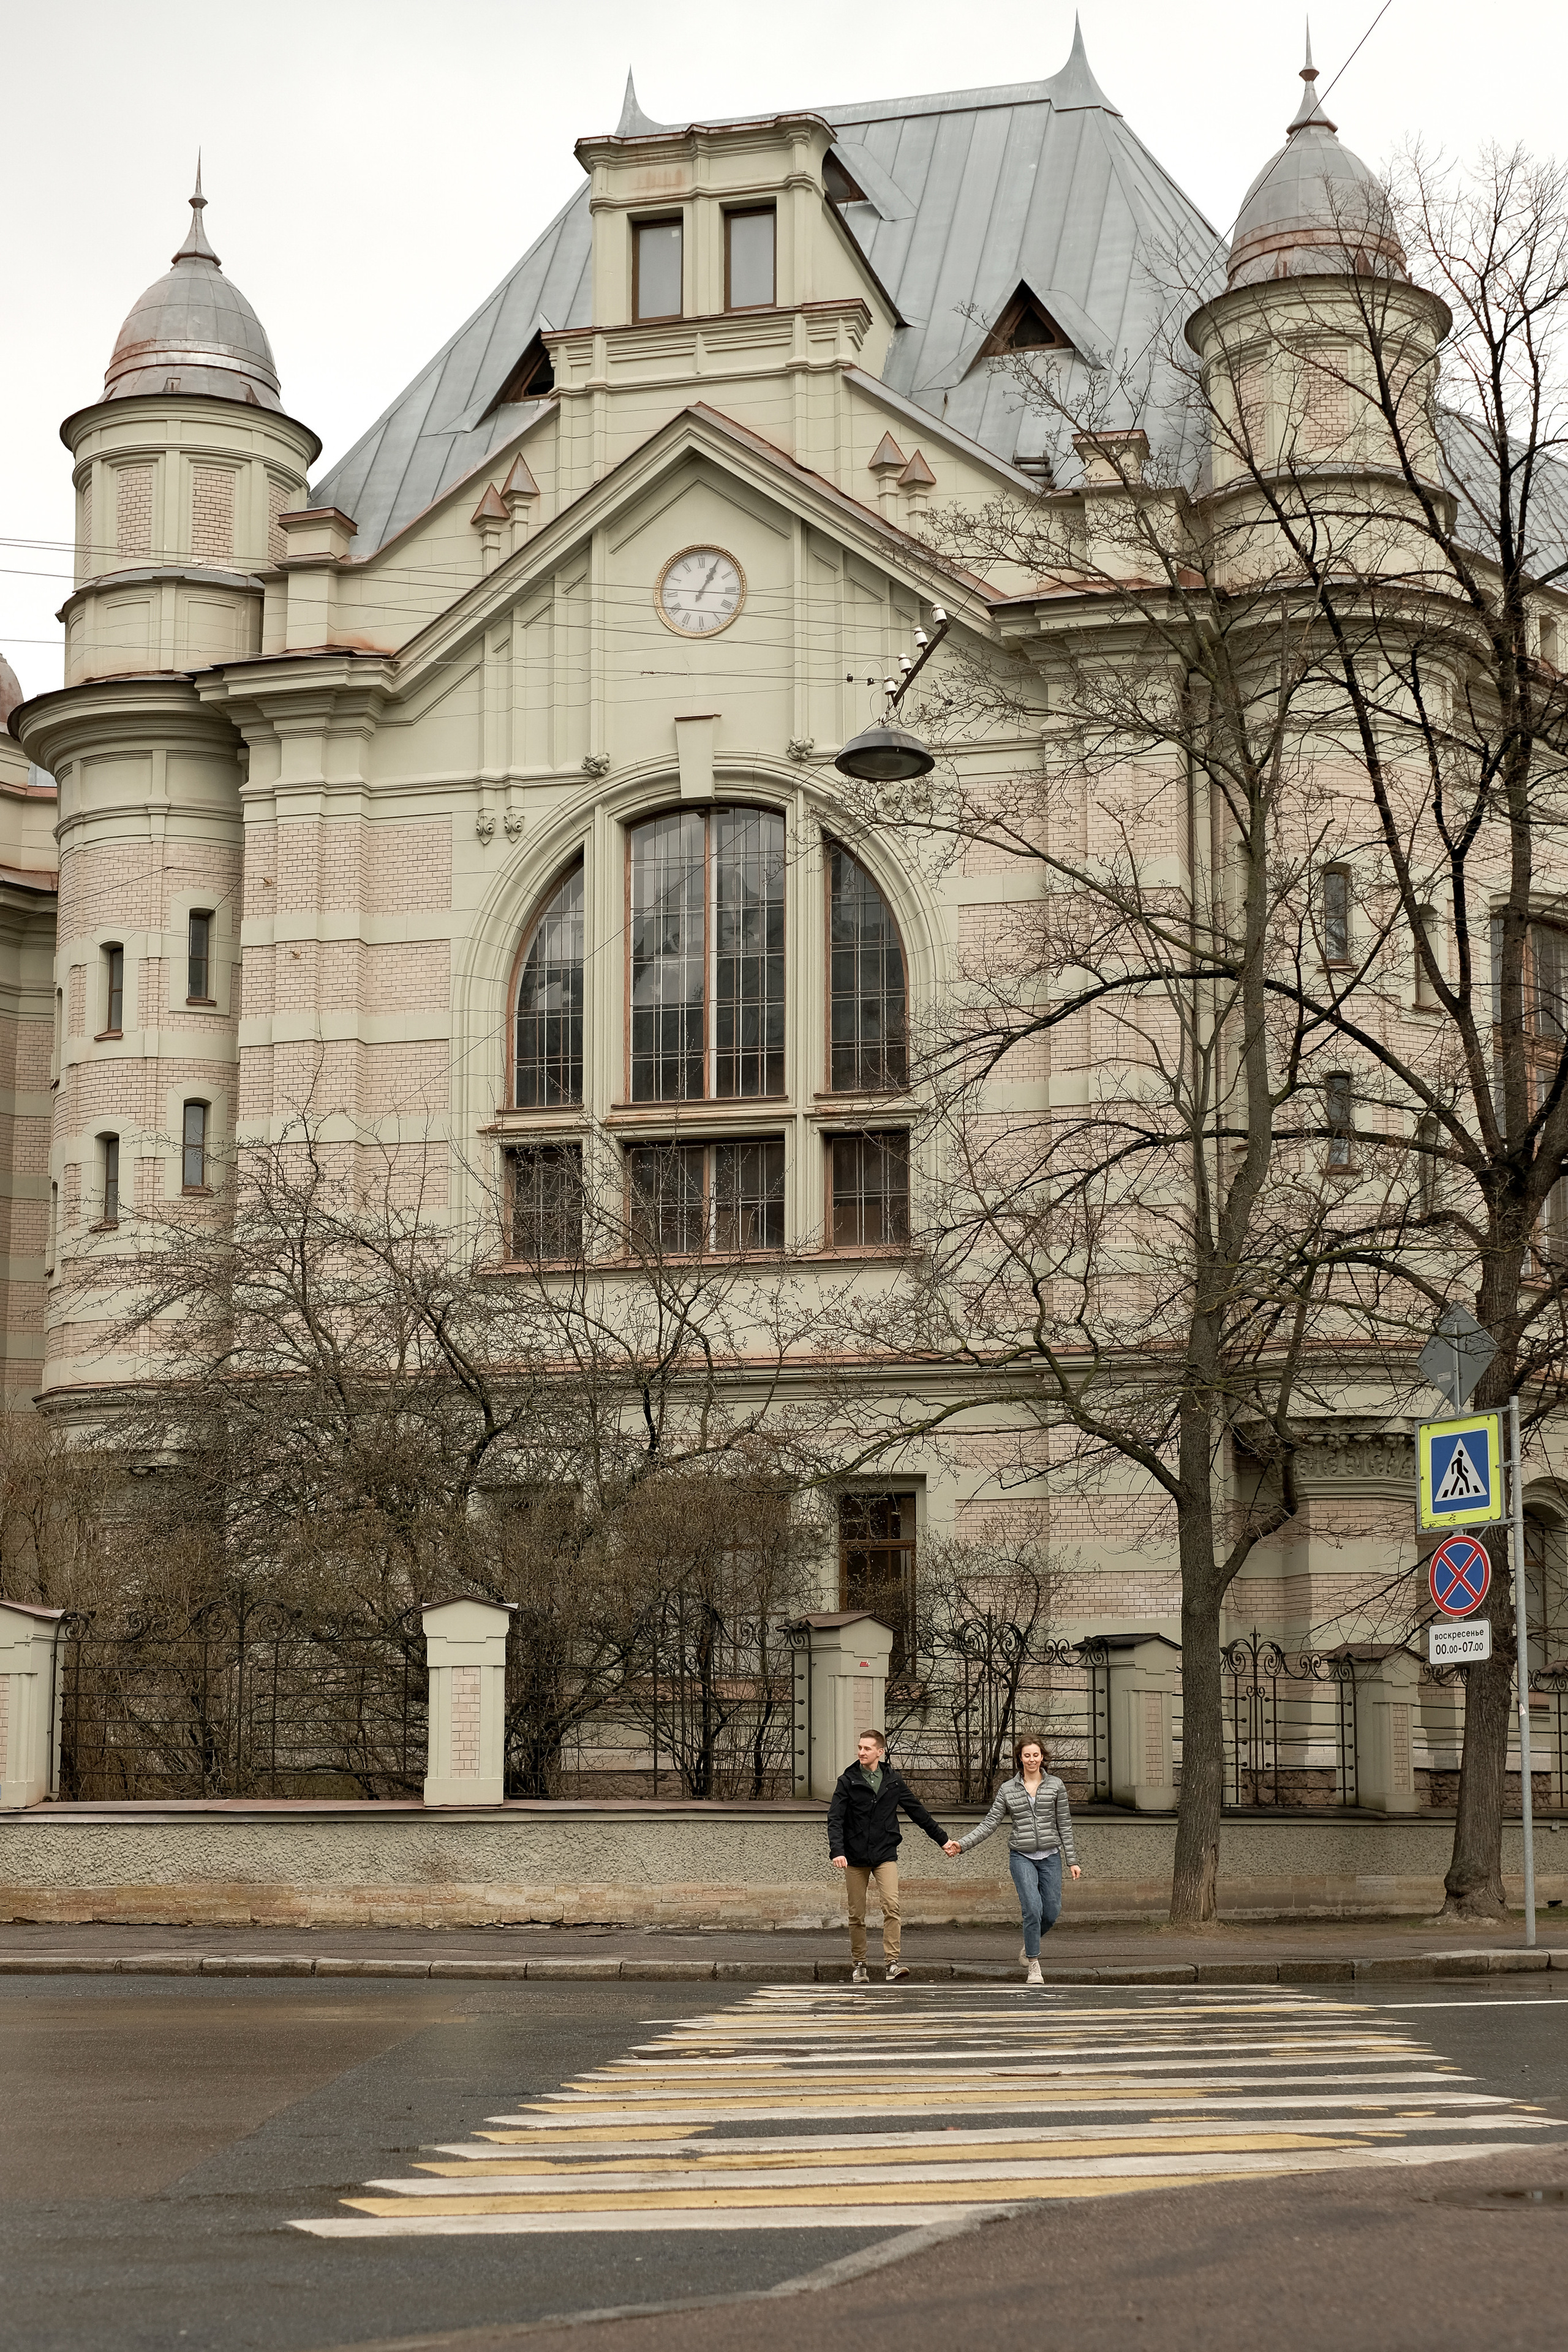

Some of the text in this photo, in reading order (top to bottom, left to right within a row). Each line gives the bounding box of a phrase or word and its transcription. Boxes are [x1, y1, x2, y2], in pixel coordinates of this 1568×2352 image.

[682, 562, 692, 574] XI
[721, 571, 733, 580] II
[682, 612, 692, 625] VII
[699, 616, 704, 627] VI
[1434, 1629, 1484, 1641] воскресенье
[1436, 1642, 1483, 1655] 00.00-07.00
